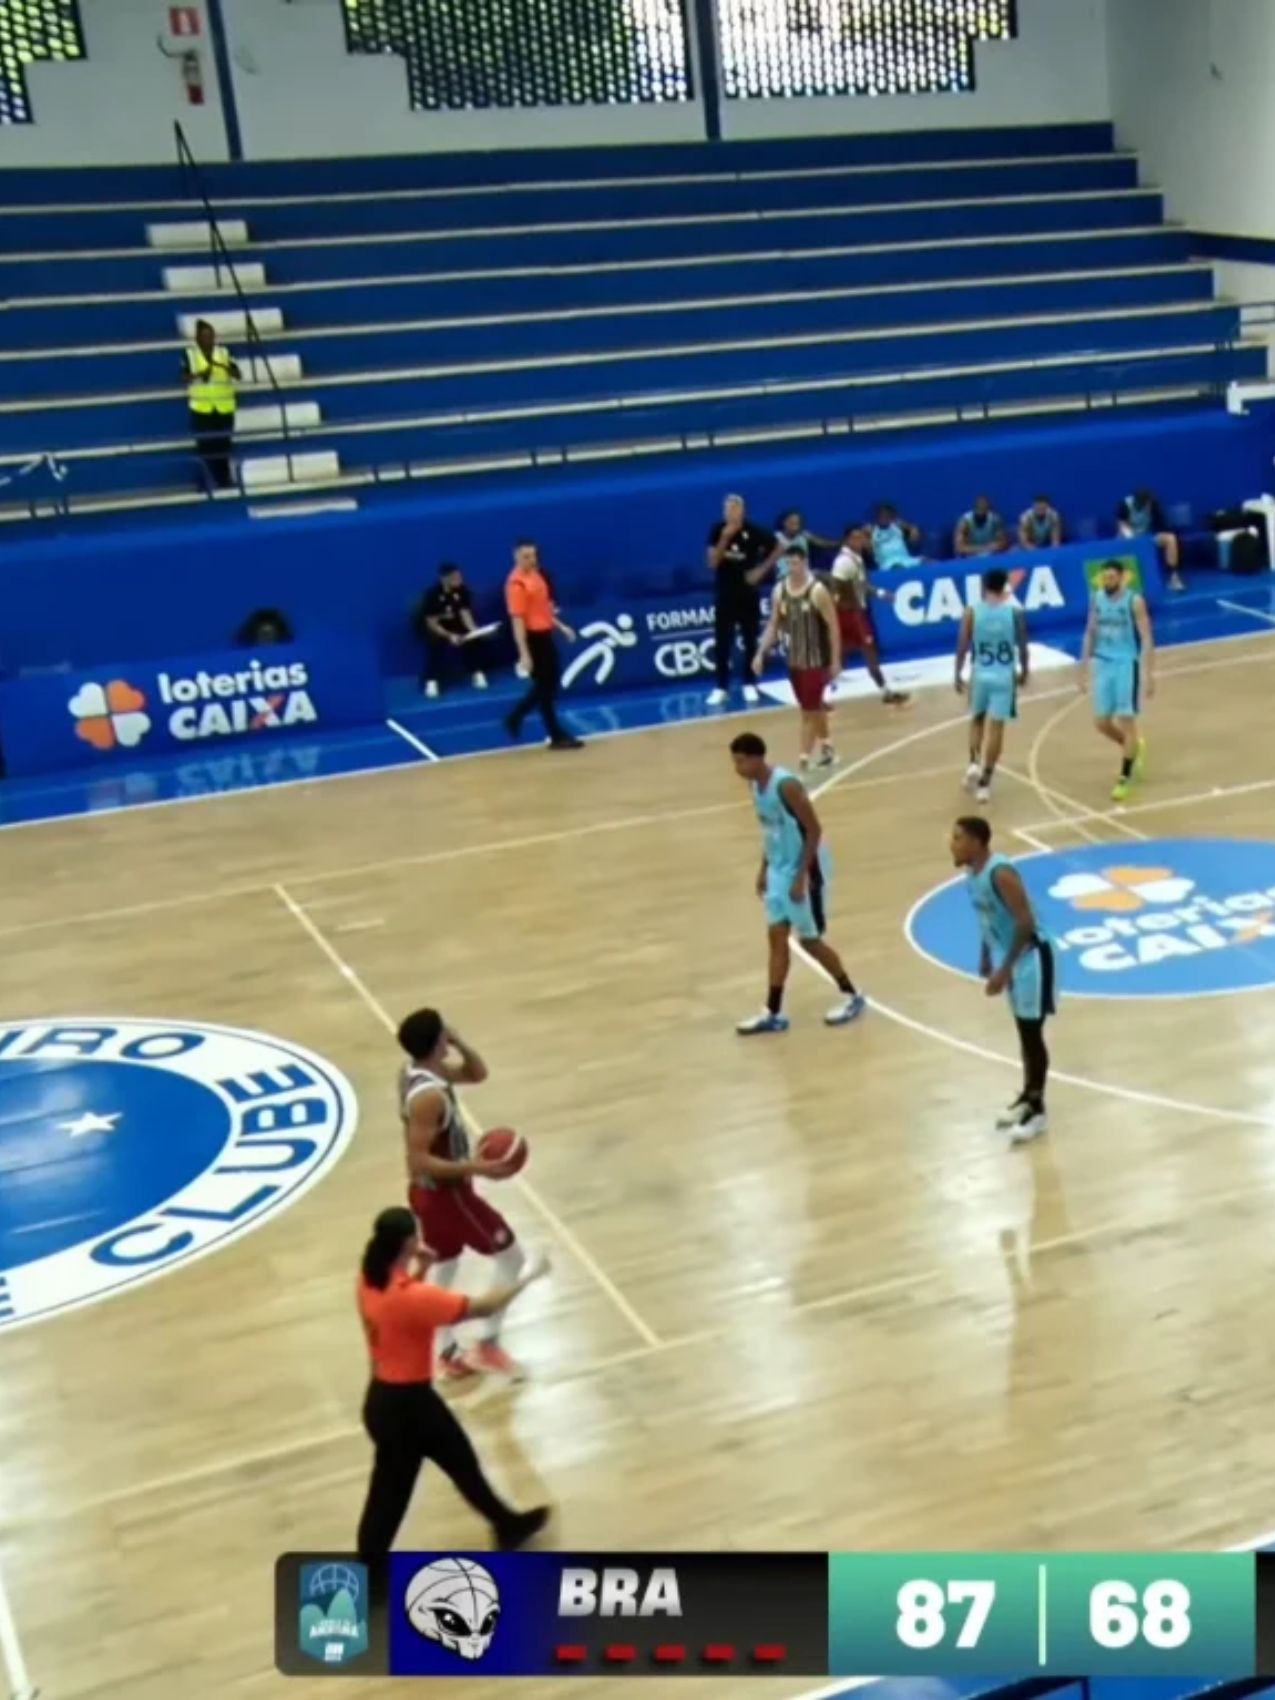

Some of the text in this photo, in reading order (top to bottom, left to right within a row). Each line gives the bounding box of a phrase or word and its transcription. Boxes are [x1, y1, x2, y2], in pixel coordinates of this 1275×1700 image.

[977, 641, 1014, 668] 58
[157, 659, 309, 704] loterias
[168, 690, 318, 741] CAIXA
[89, 1063, 328, 1267] CLUBE
